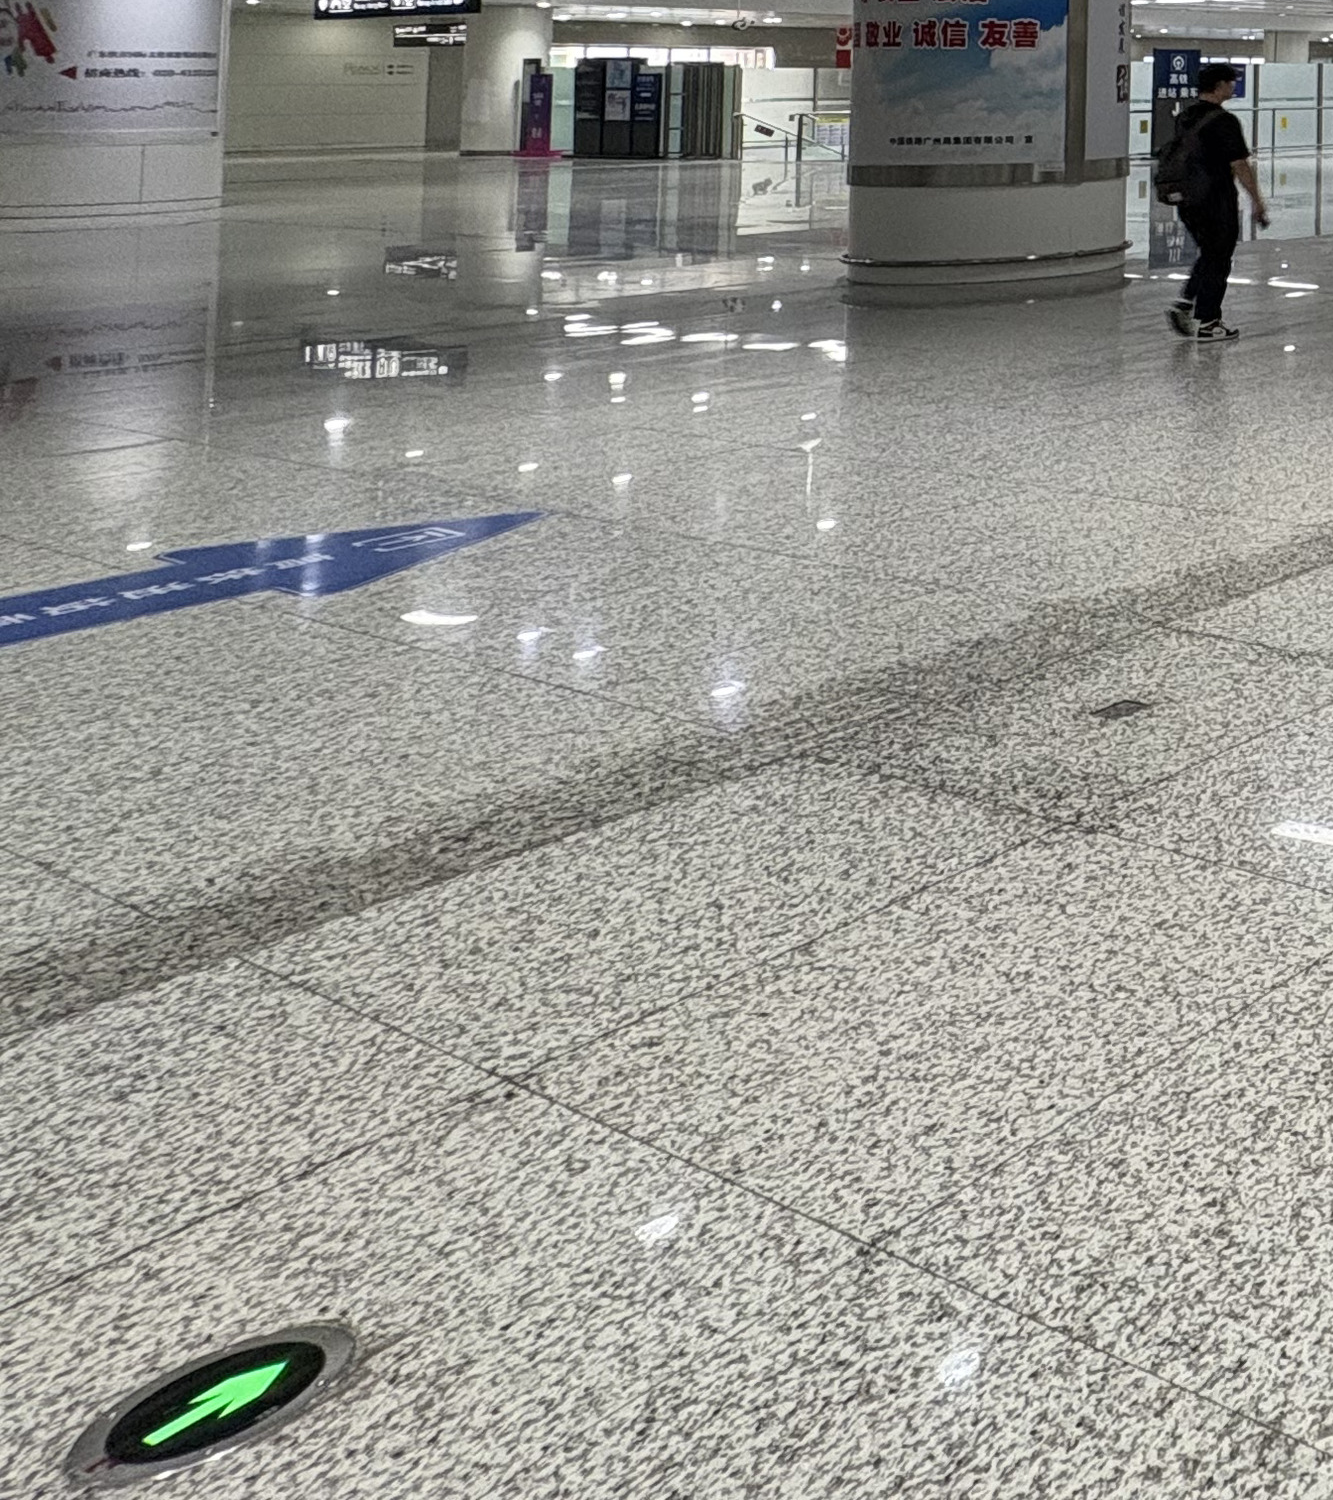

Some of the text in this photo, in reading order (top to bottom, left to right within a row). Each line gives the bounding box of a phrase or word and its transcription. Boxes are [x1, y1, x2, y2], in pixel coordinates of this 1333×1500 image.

[866, 21, 902, 49] 敬业
[913, 18, 968, 49] 诚信
[978, 18, 1041, 50] 友善
[1169, 73, 1188, 85] 高铁
[1157, 87, 1198, 99] 进站 乘车
